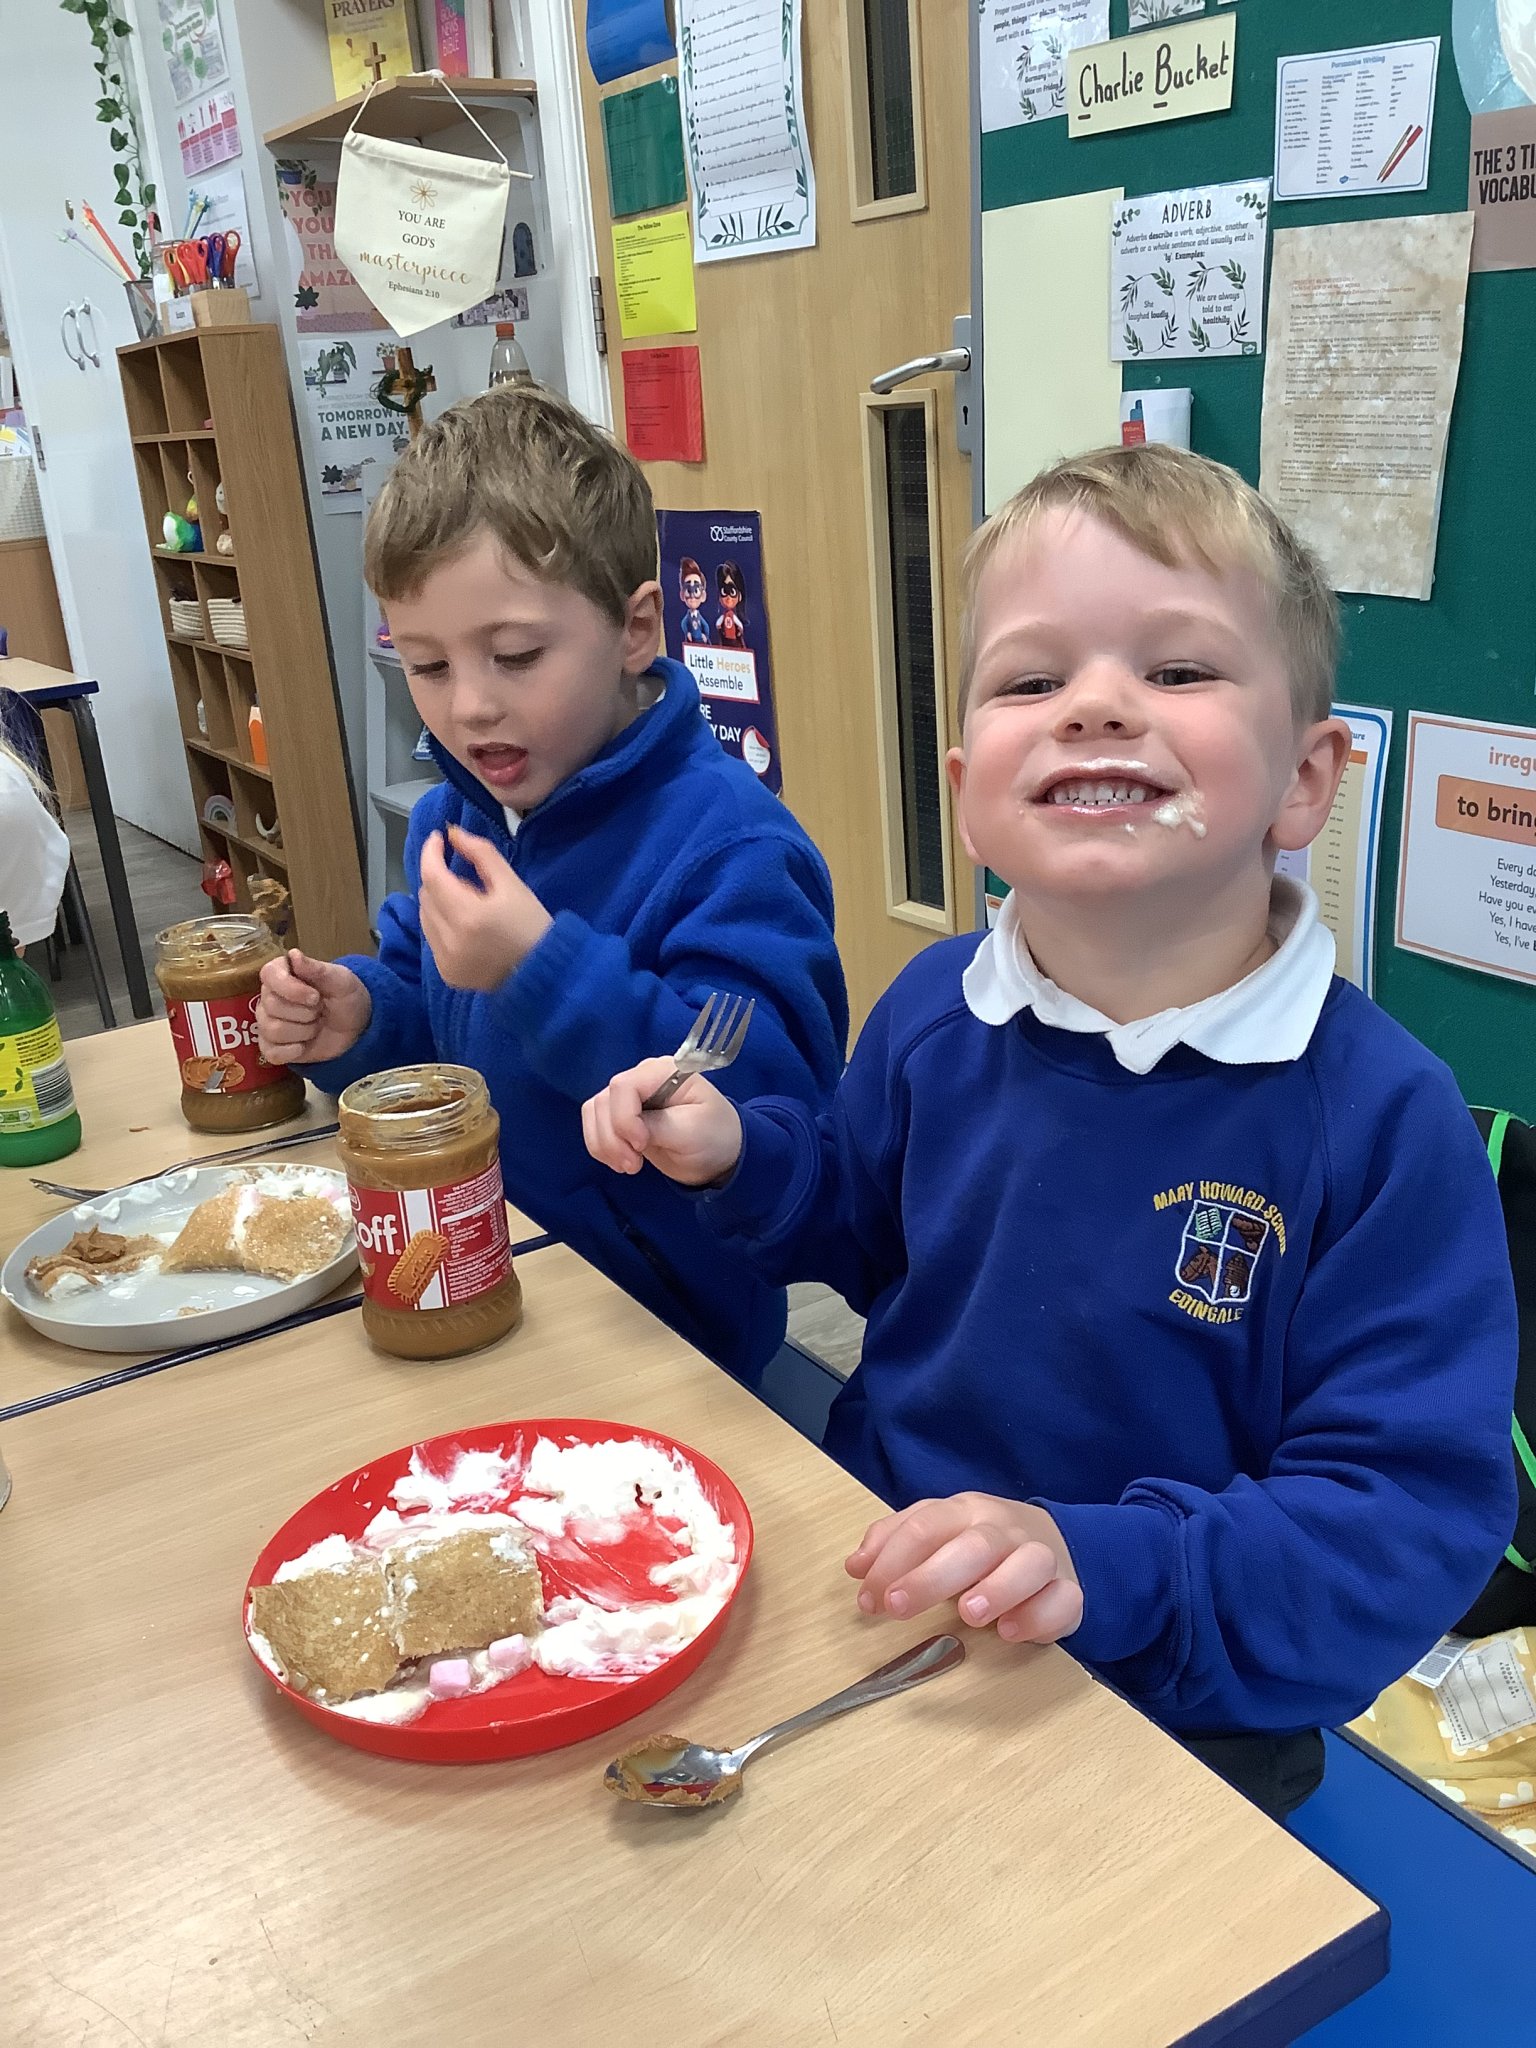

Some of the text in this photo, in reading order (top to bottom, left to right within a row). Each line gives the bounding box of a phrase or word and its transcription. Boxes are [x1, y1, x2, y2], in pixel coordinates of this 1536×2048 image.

[332, 0, 395, 18] PRAYERS
[1079, 39, 1230, 108] Charlie Bucket
[1474, 148, 1503, 176] THE
[1506, 145, 1516, 172] 3
[290, 189, 333, 208] YOU
[398, 209, 446, 230] YOU ARE
[1161, 199, 1212, 225] ADVERB
[402, 233, 436, 249] GOD'S
[1126, 234, 1147, 243] Adverbs
[1148, 230, 1173, 240] describe
[1225, 222, 1249, 231] another
[1121, 246, 1139, 255] adverb
[1153, 242, 1170, 252] whole
[1171, 240, 1196, 249] sentence
[1197, 237, 1209, 246] and
[1210, 235, 1233, 245] usually
[1234, 233, 1246, 242] end
[1247, 232, 1254, 241] in
[1175, 250, 1205, 261] Examples:
[359, 251, 472, 285] masterpiece
[388, 280, 441, 299] Ephesians 2:10
[1196, 292, 1240, 302] We are always
[1143, 299, 1154, 308] She
[1202, 304, 1233, 313] told to eat
[1128, 311, 1150, 323] laughed
[318, 407, 393, 423] TOMORROW
[321, 421, 409, 441] A NEW DAY.
[690, 654, 751, 673] Little Heroes
[699, 673, 744, 691] Assemble
[719, 724, 742, 742] DAY
[1457, 795, 1479, 818] to
[1497, 858, 1524, 877] Every
[1479, 890, 1503, 907] Have
[1505, 899, 1524, 912] you
[1489, 910, 1506, 928] Yes,
[1494, 930, 1530, 950] Yes, I've
[1153, 1181, 1195, 1212] MARY
[1199, 1180, 1266, 1213] HOWARD
[1168, 1288, 1245, 1325] EDINGALE
